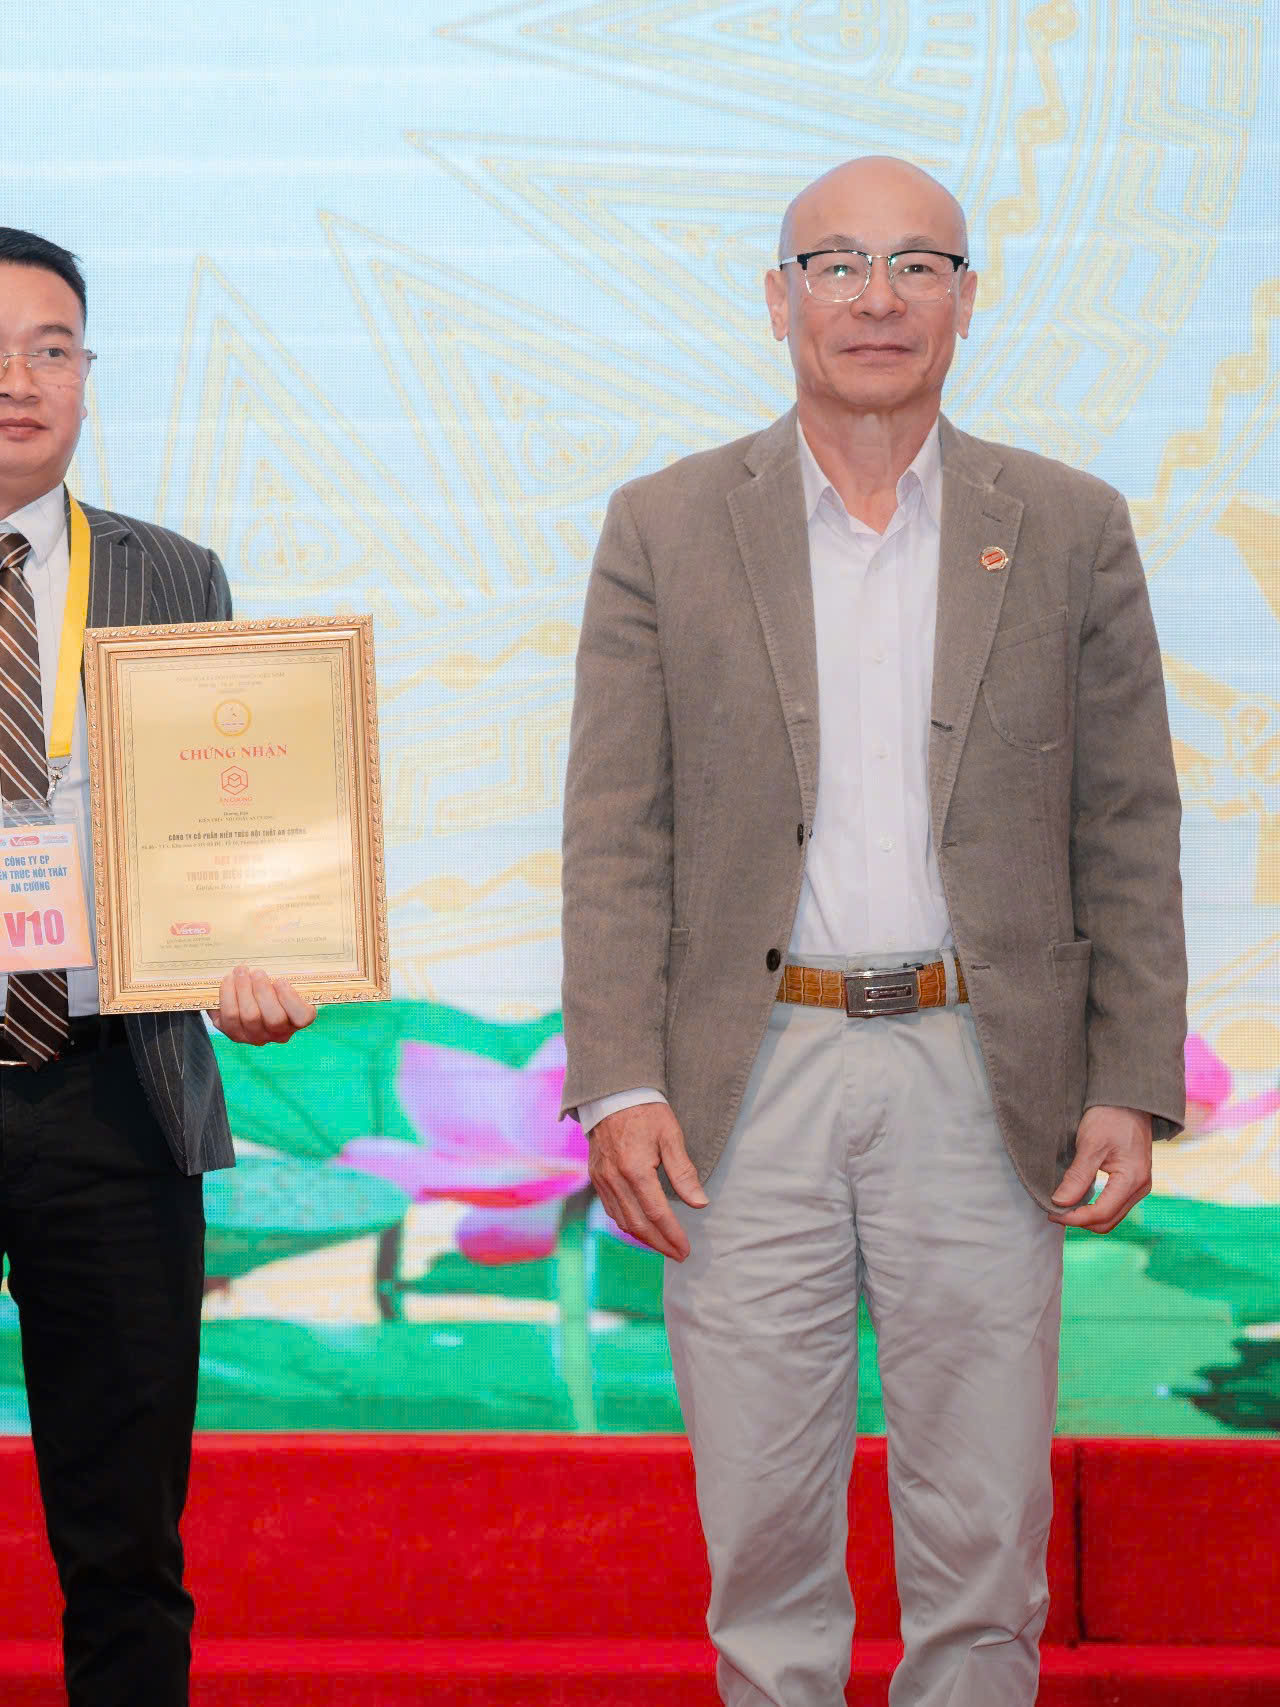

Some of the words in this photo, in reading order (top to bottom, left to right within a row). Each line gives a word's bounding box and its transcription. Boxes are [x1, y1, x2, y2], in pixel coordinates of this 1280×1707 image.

[179, 745, 236, 760] CHỨNG
[4, 855, 26, 867] CÔNG
[27, 855, 37, 866] TY
[39, 855, 50, 865] CP
[10, 882, 22, 893] AN
[3, 908, 65, 948] V10
